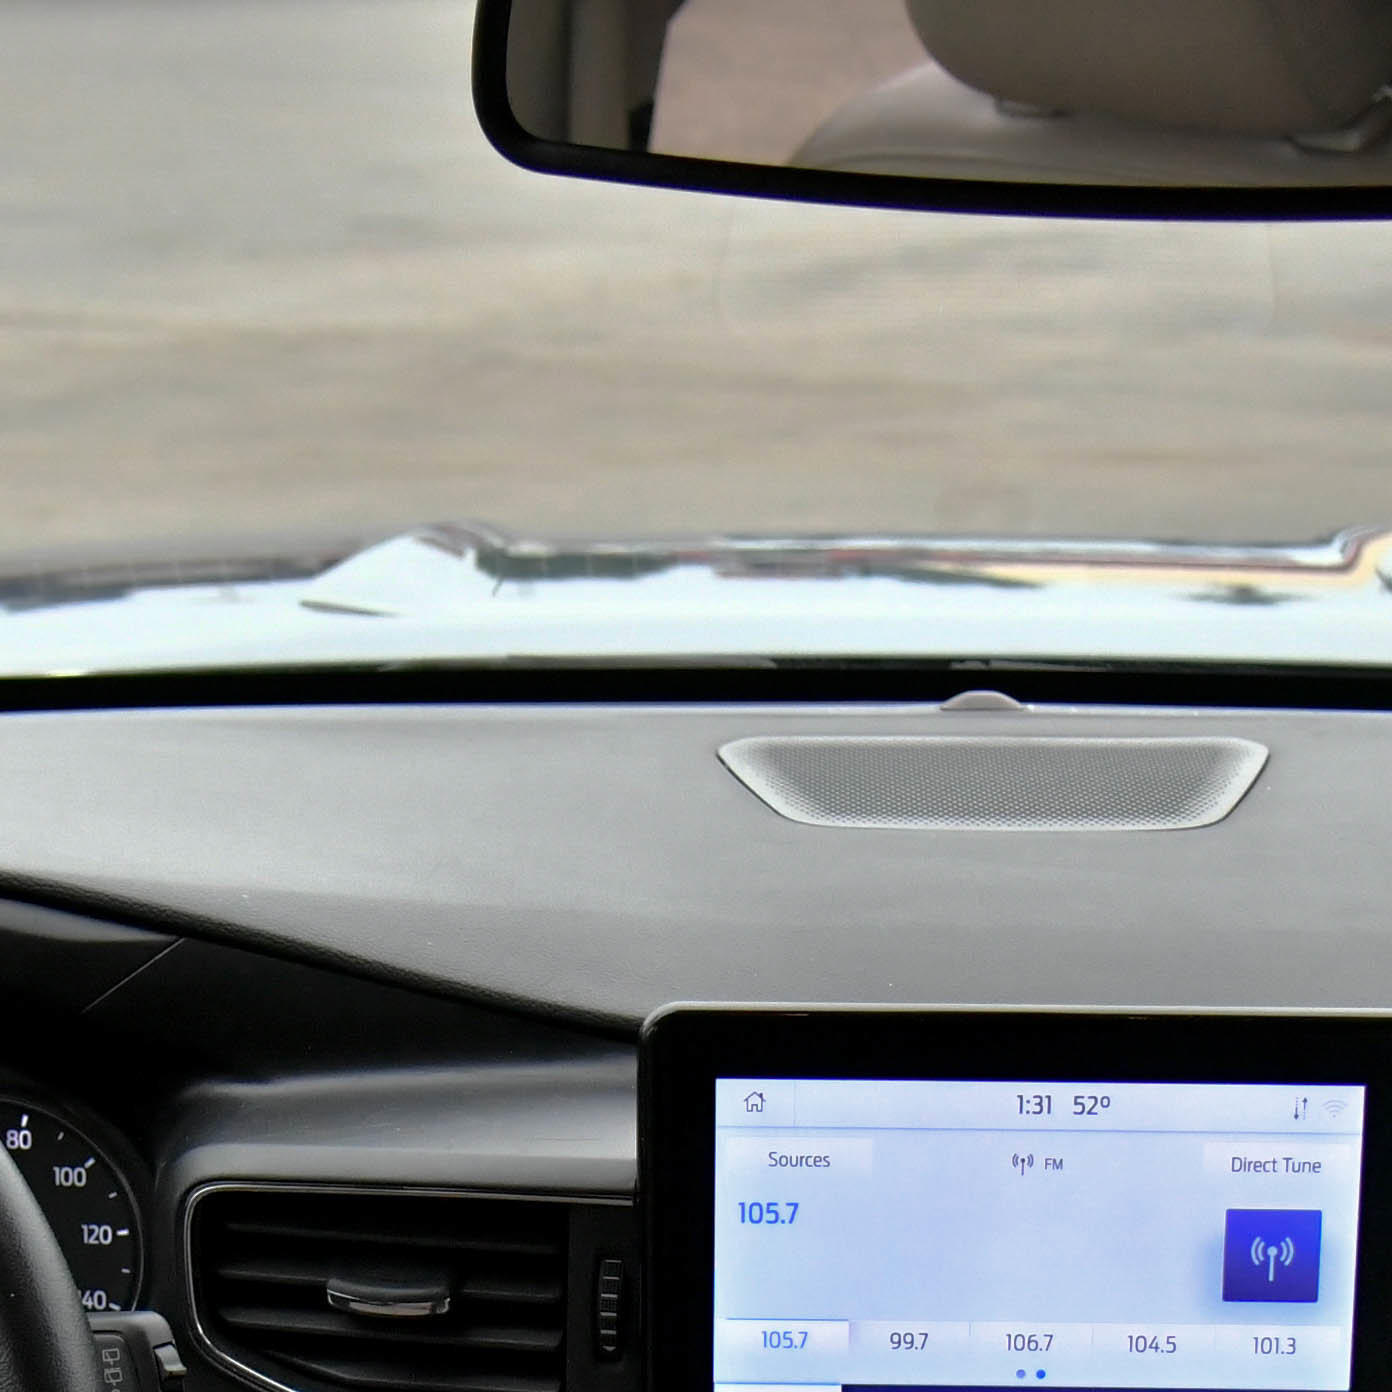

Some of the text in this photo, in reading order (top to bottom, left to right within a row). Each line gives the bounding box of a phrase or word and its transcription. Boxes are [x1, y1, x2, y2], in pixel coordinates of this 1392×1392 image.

[1016, 1094, 1053, 1116] 1:31
[6, 1129, 32, 1150] 80
[768, 1151, 831, 1169] Sources
[1044, 1157, 1064, 1171] FM
[1231, 1156, 1322, 1174] Direct Tune
[53, 1166, 87, 1187] 100
[737, 1201, 800, 1225] 105.7
[81, 1223, 113, 1245] 120
[761, 1330, 809, 1350] 105.7
[889, 1331, 929, 1351] 99.7
[1005, 1332, 1054, 1352] 106.7
[1127, 1334, 1177, 1354] 104.5
[1253, 1335, 1297, 1355] 101.3
